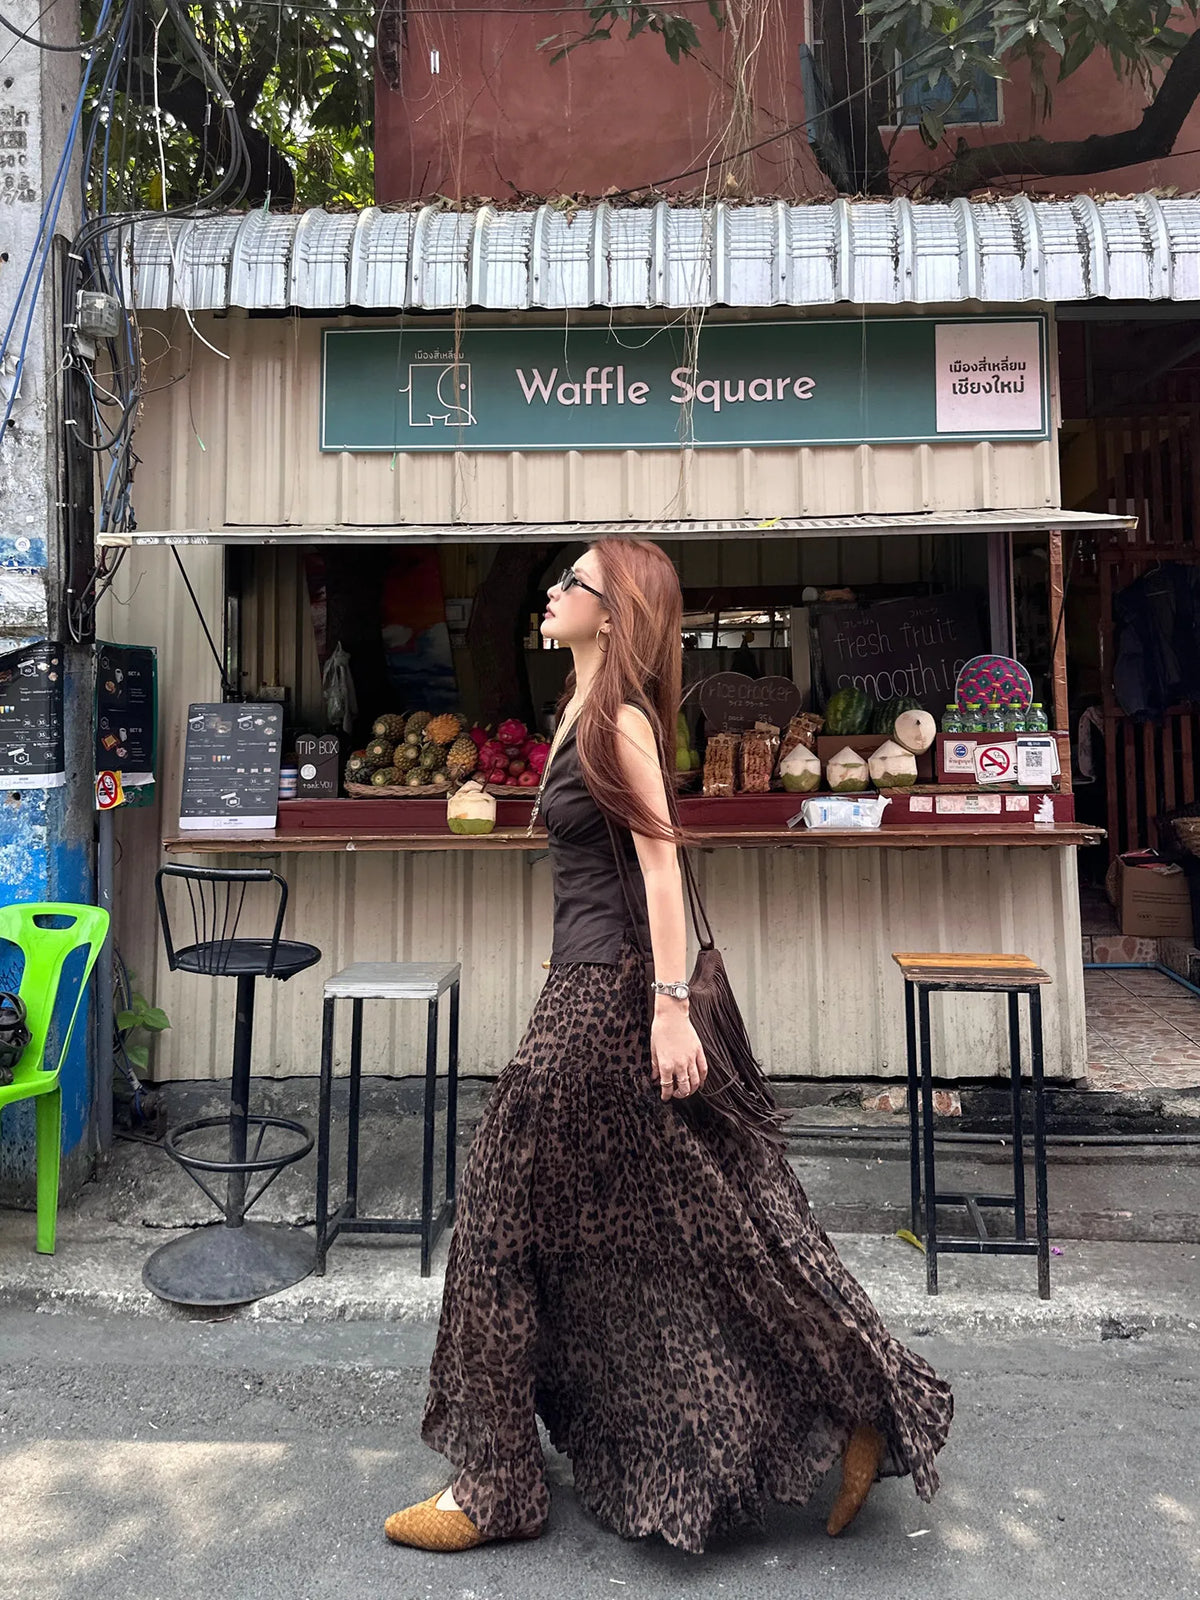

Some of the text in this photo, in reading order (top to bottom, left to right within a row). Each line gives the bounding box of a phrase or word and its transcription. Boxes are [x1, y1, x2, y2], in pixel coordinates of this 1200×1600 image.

[949, 356, 1027, 373] เมืองสี่เหลี่ยม
[515, 365, 817, 412] Waffle Square
[952, 374, 1025, 396] เชียงใหม่
[833, 618, 957, 661] fresh fruit
[296, 740, 339, 755] TIP BOX
